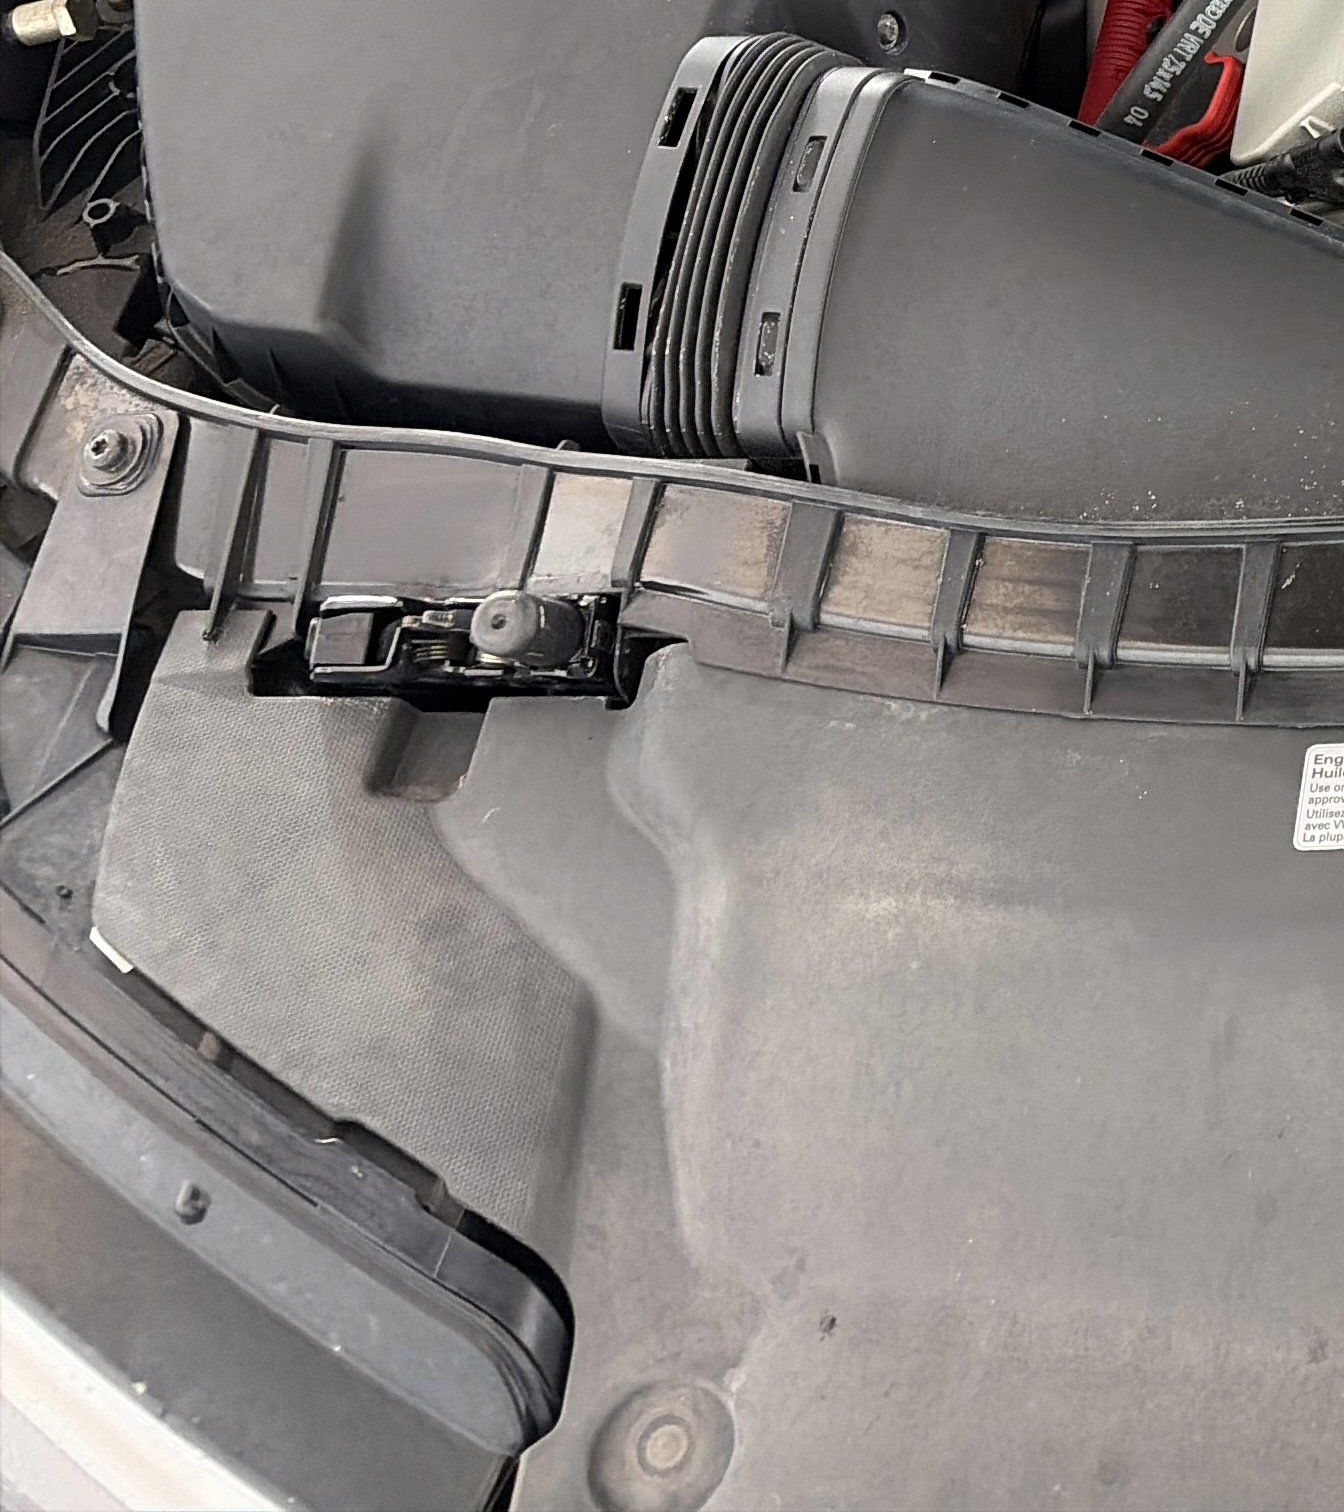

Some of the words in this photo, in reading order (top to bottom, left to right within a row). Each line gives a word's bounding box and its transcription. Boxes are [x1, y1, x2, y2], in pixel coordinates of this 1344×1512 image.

[1189, 13, 1217, 39] DE
[1173, 32, 1204, 62] VRT
[1124, 106, 1149, 127] 04
[1310, 782, 1331, 793] Use
[1305, 820, 1330, 830] avec
[1303, 833, 1315, 842] La
